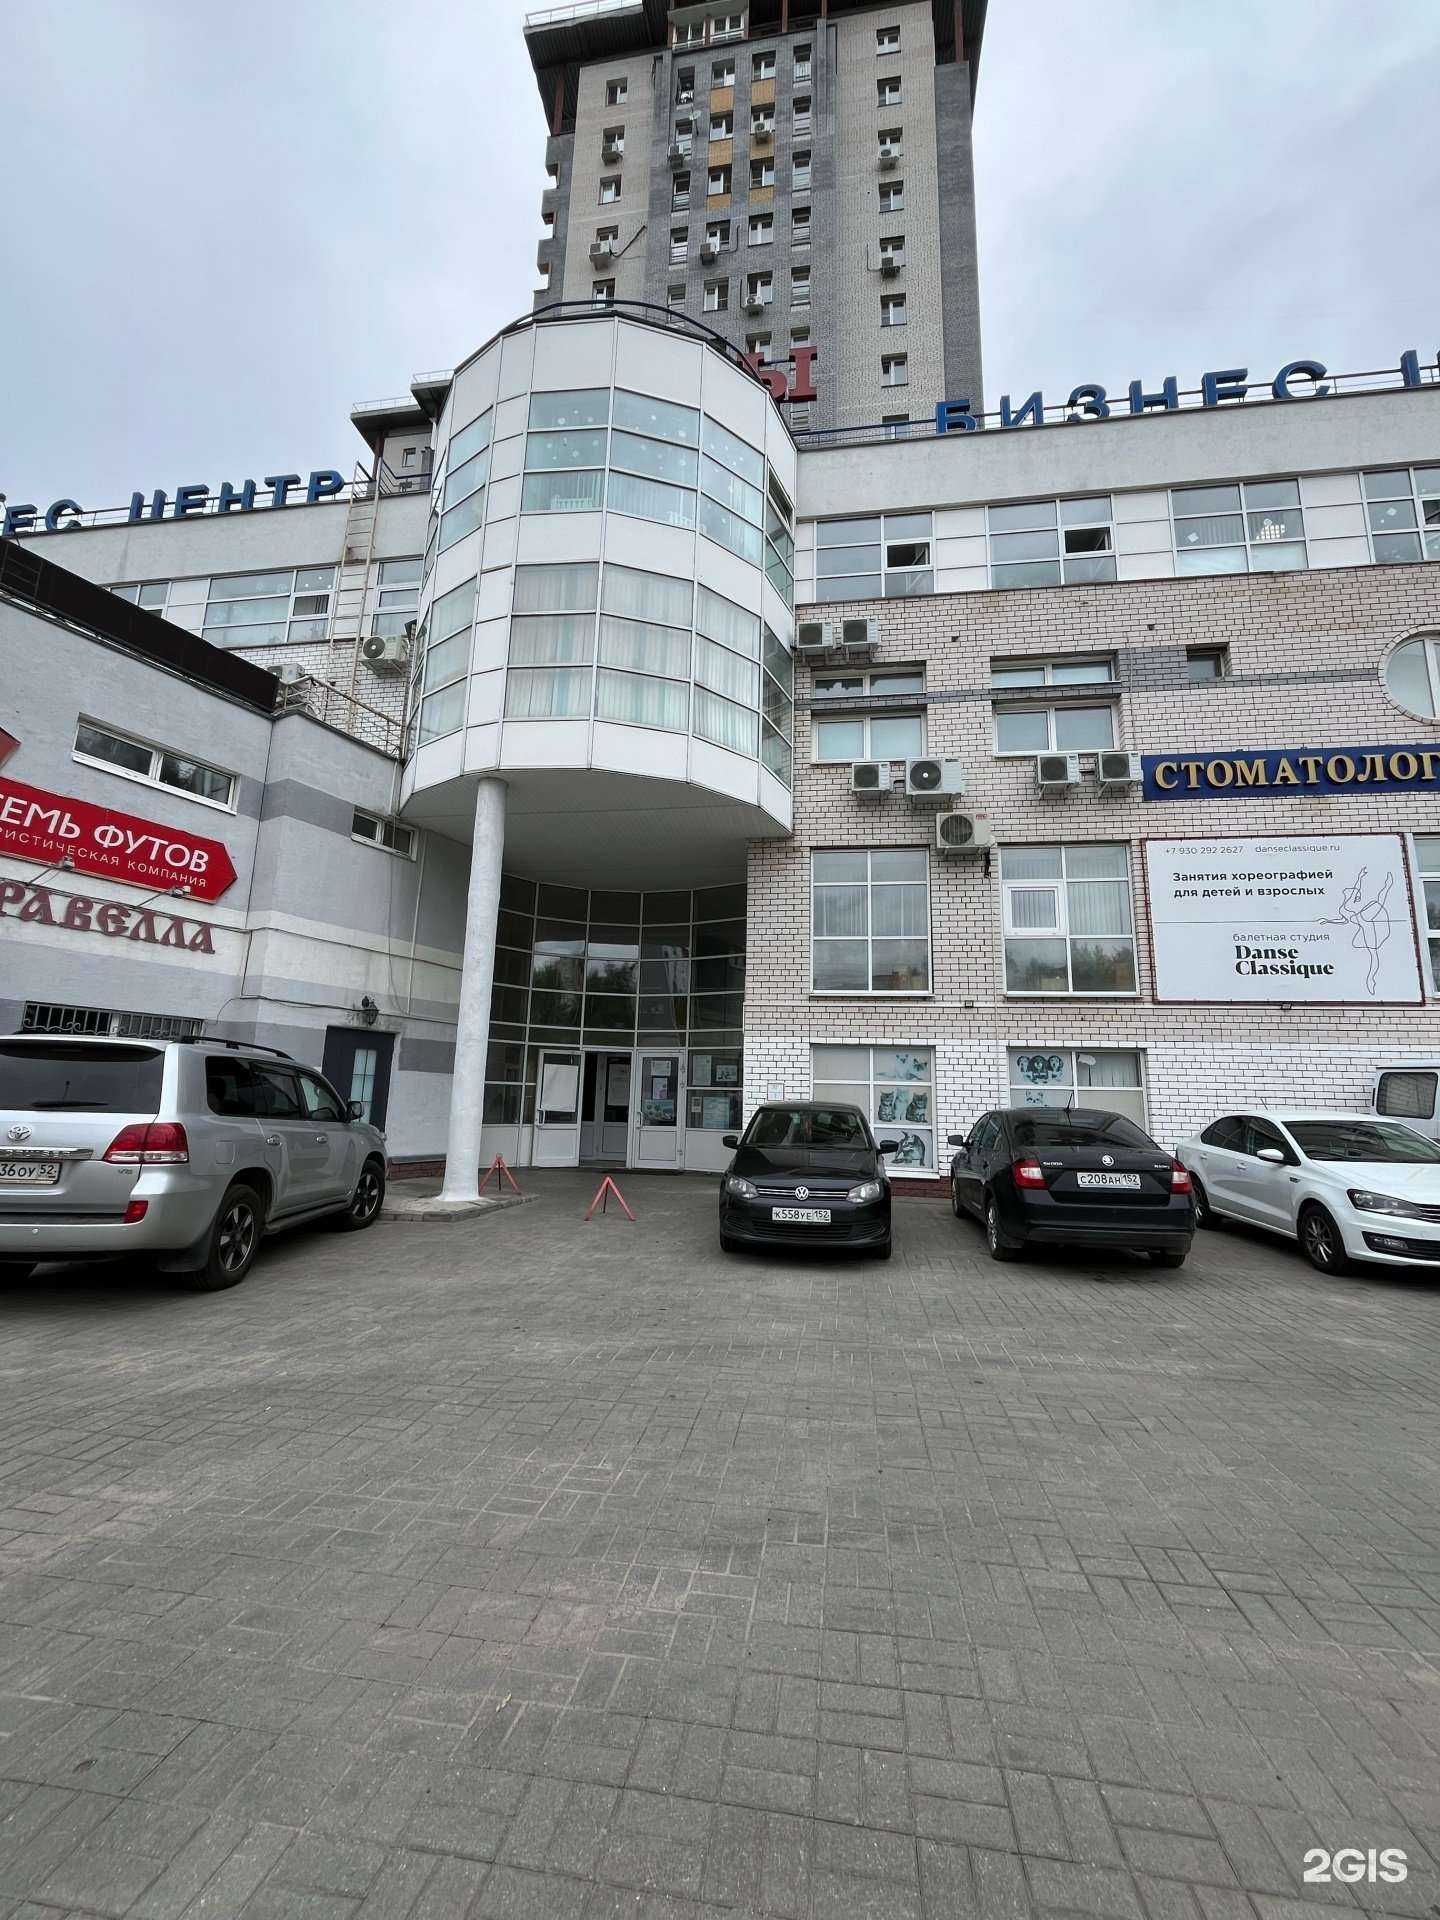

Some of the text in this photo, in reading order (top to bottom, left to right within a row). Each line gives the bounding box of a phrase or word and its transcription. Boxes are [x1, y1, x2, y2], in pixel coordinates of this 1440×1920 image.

[936, 360, 1328, 434] БИЗНЕС
[1155, 752, 1440, 789] СТОМАТОЛОГ
[0, 793, 209, 872] ЕМЬ ФУТОВ
[0, 827, 207, 887] ИСТИЧЕСКАЯ КОМПАНИЯ
[1179, 847, 1198, 855] 930
[1200, 846, 1221, 854] 292
[1221, 846, 1244, 854] 2627
[1173, 870, 1333, 882] Занятия хореографией
[1174, 886, 1325, 898] для детей и взрослых
[1232, 933, 1330, 943] балетная студия
[1235, 945, 1299, 960] Danse
[1235, 960, 1335, 979] Classique
